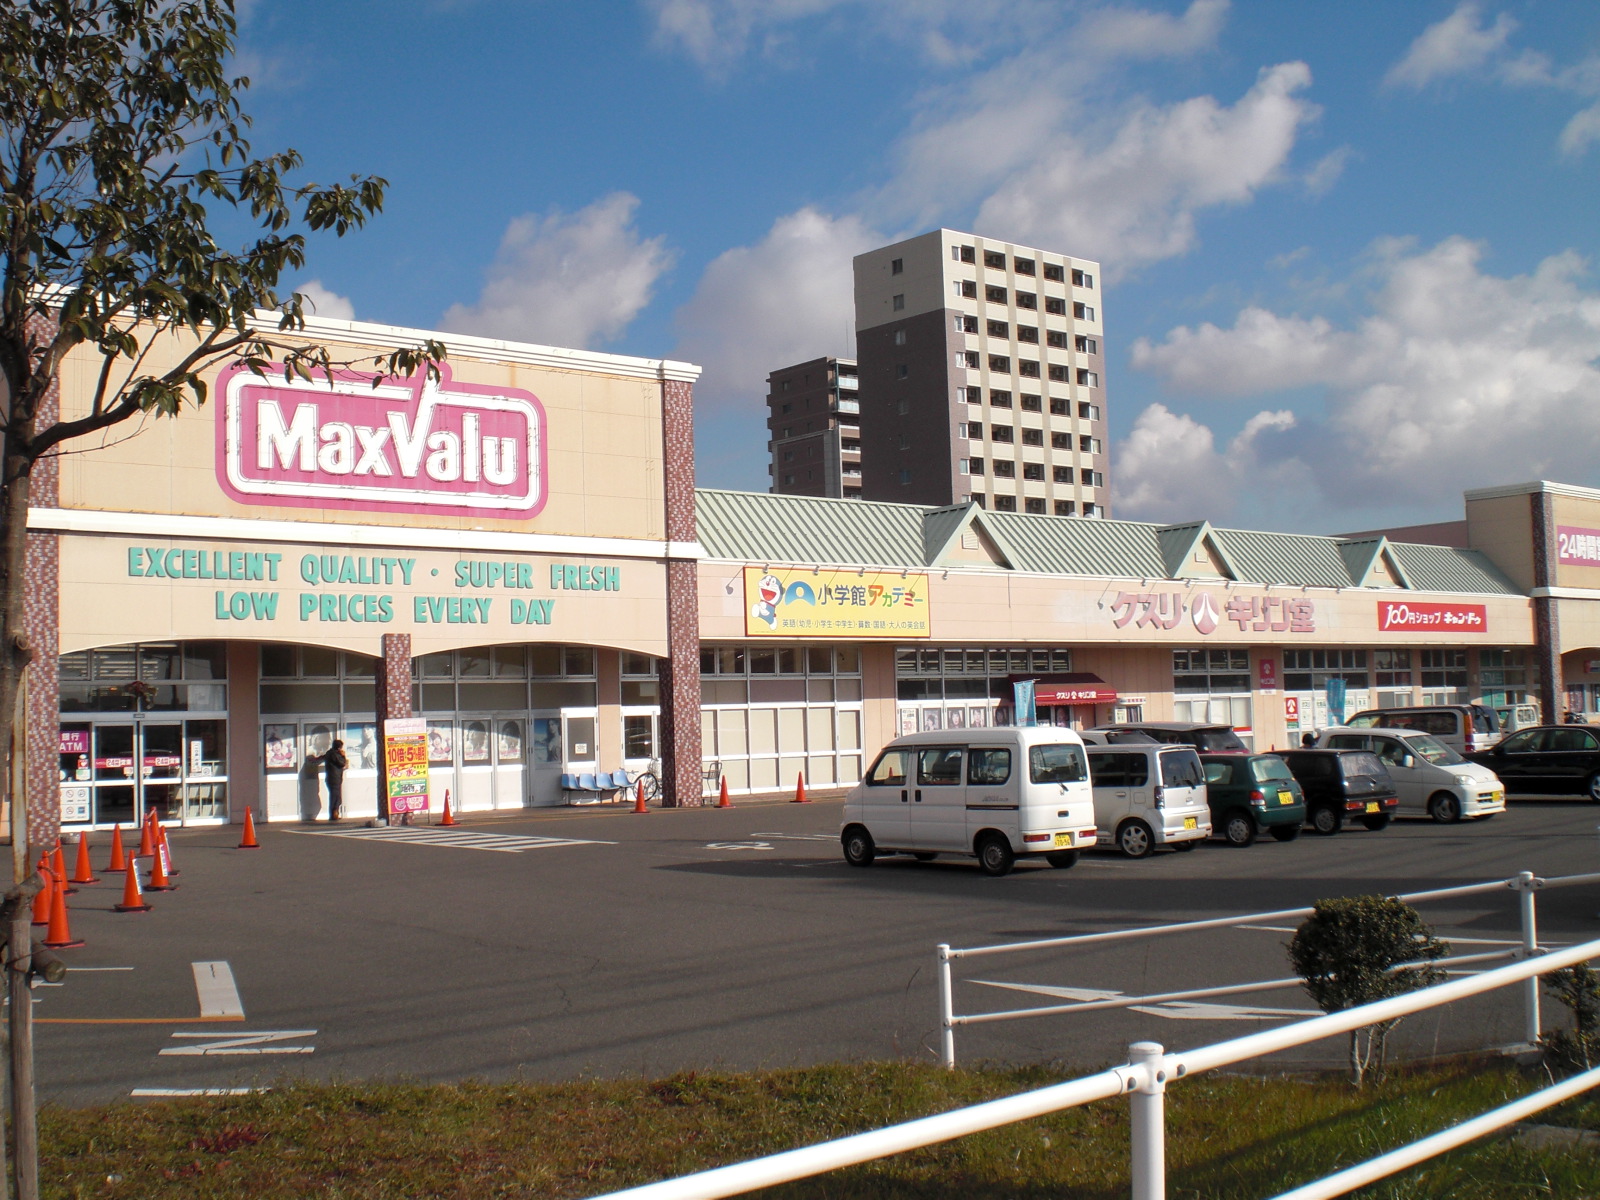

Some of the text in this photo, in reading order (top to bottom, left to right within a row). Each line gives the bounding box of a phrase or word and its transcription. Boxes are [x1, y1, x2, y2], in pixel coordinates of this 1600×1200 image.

[257, 372, 518, 486] MaxValu
[128, 547, 620, 591] EXCELLENT QUALITY SUPER FRESH
[215, 591, 555, 624] LOW PRICES EVERY DAY
[818, 583, 924, 608] 小学館アカデミー
[1111, 591, 1316, 632] クスリ キリン堂
[1384, 604, 1441, 629] 100円ショップ
[59, 742, 83, 751] ATM
[61, 732, 80, 741] 銀行
